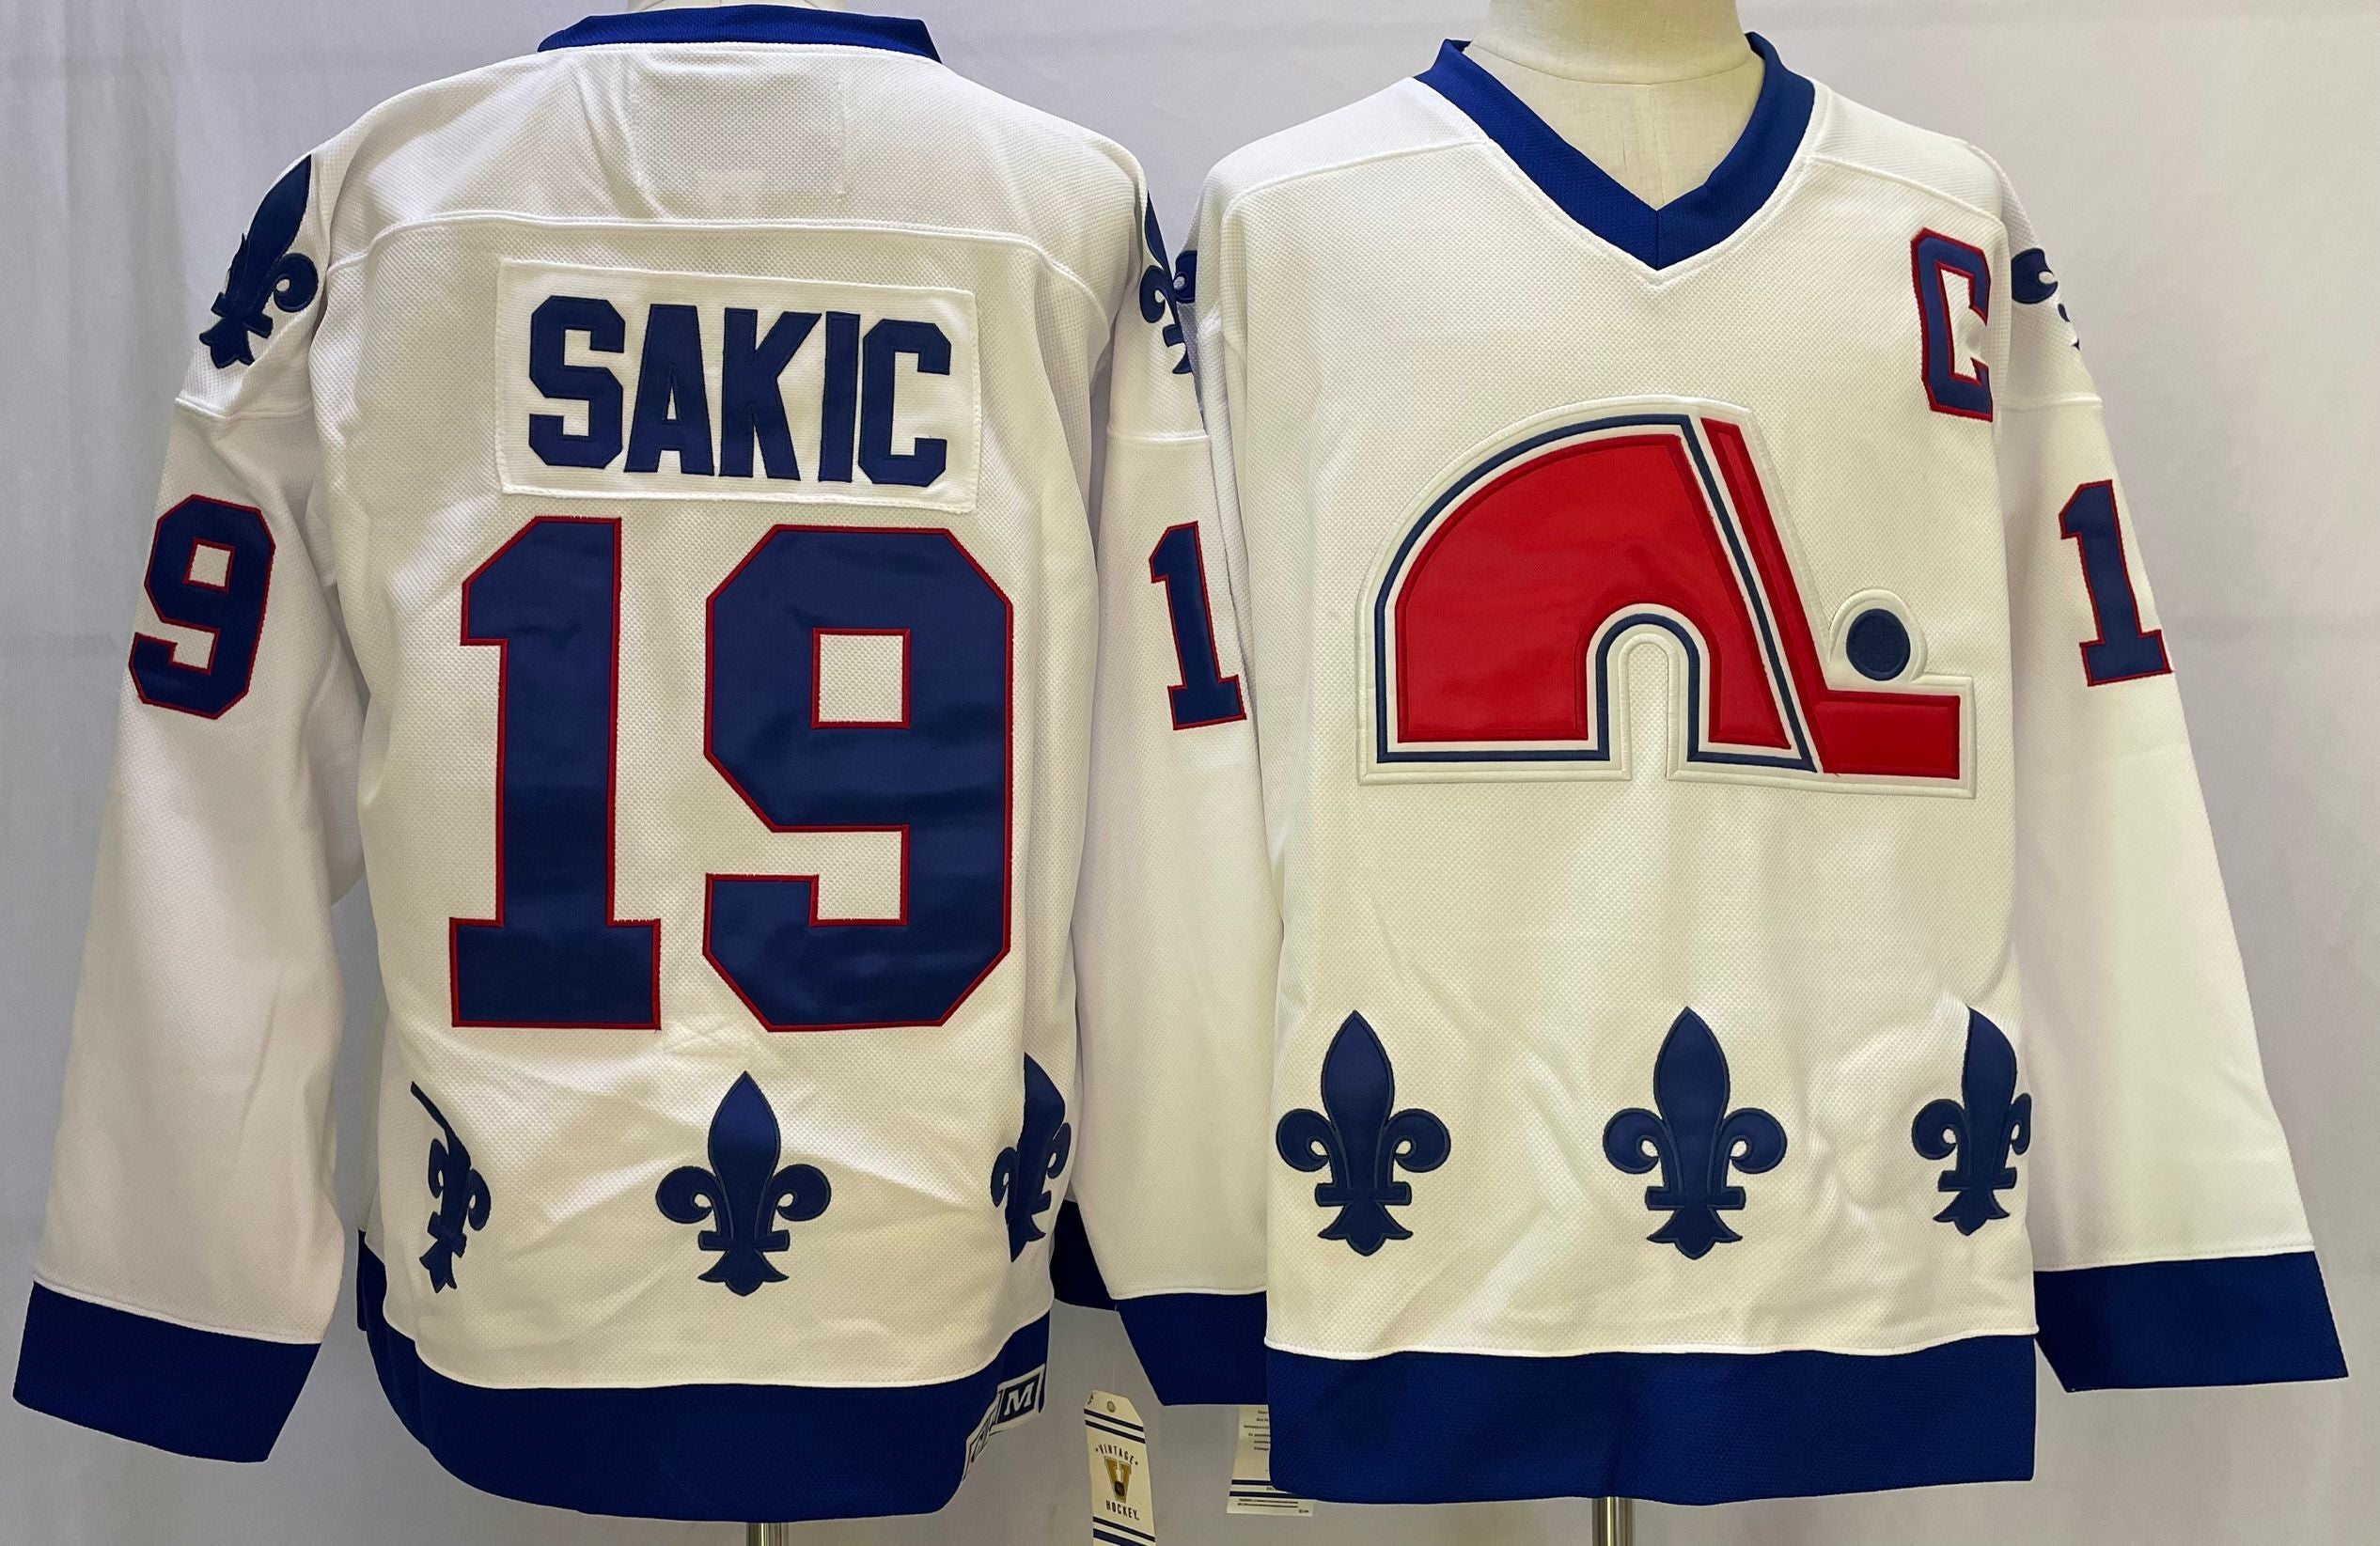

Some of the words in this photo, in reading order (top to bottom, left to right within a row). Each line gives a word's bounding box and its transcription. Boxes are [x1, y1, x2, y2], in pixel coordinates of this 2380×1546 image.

[528, 295, 951, 487] SAKIC
[1911, 227, 1993, 422] C
[129, 494, 275, 720] 9
[1149, 521, 1246, 730] 1
[2059, 479, 2172, 687] 1
[449, 515, 1013, 1032] 19
[1099, 1444, 1134, 1465] VINTAGE
[1105, 1500, 1138, 1521] HOCKEY
